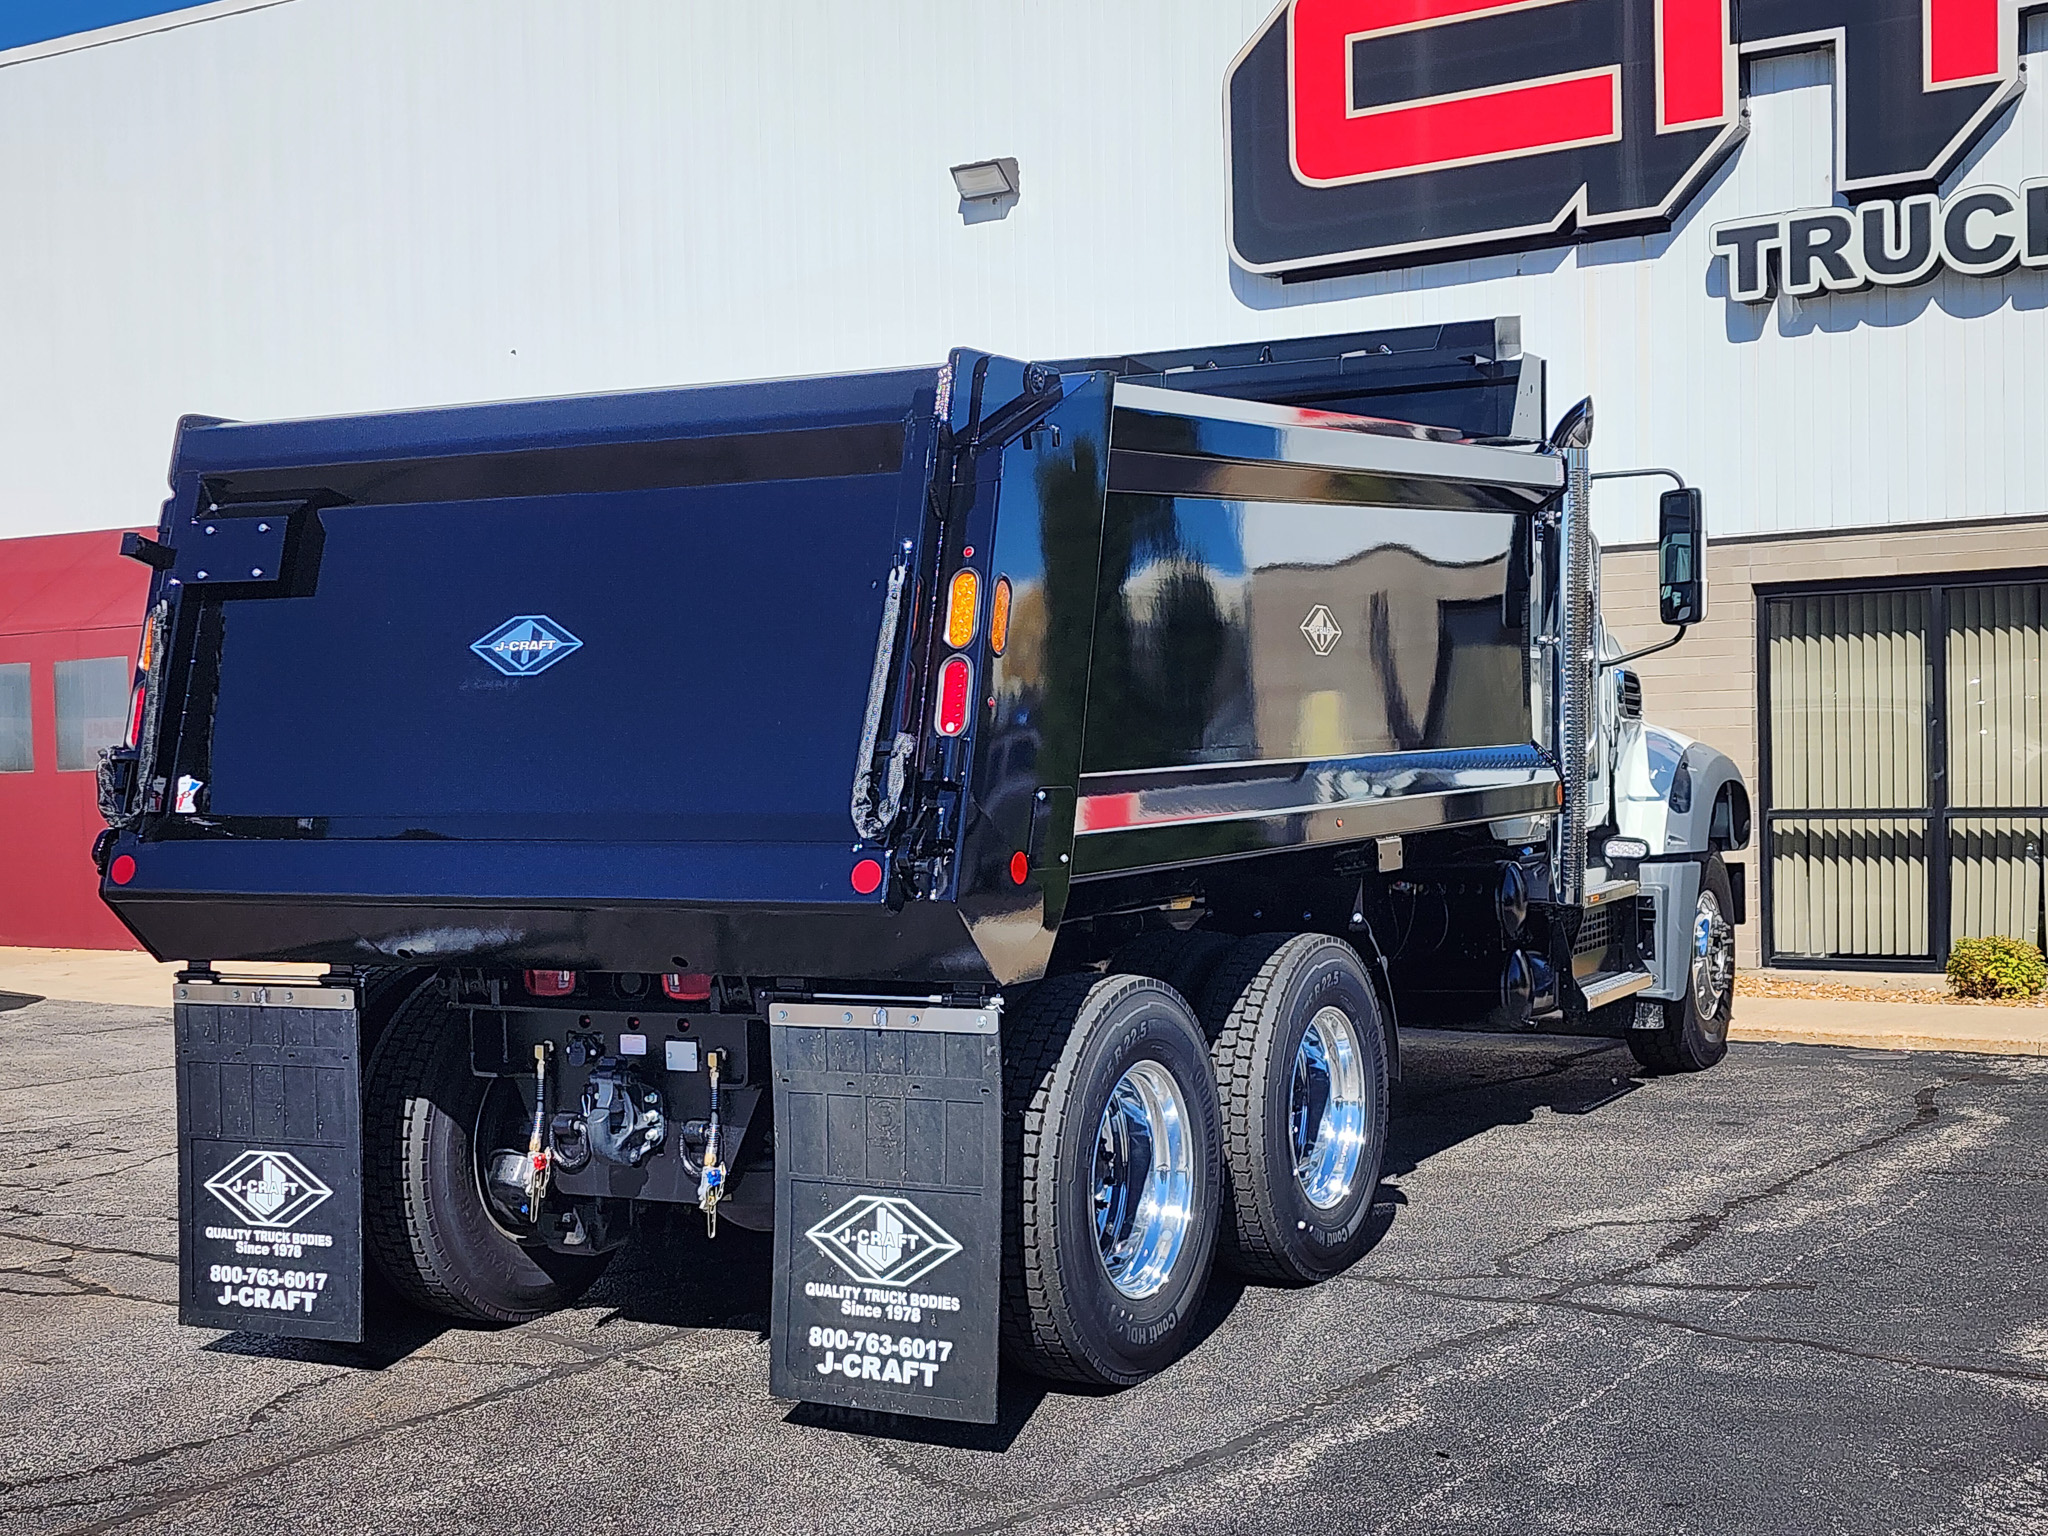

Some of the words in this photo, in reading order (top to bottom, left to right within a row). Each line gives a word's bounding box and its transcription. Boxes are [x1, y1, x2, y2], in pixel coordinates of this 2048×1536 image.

[495, 640, 556, 652] J-CRAFT
[1321, 970, 1340, 992] 22.5
[1123, 1020, 1148, 1052] 22.5
[232, 1179, 299, 1196] J-CRAFT
[205, 1226, 252, 1241] QUALITY
[253, 1230, 291, 1244] TRUCK
[292, 1233, 333, 1247] BODIES
[839, 1228, 920, 1250] J-CRAFT
[235, 1241, 270, 1256] Since
[272, 1244, 303, 1258] 1978
[210, 1265, 328, 1291] 800-763-6017
[217, 1285, 318, 1312] J-CRAFT
[805, 1282, 862, 1300] QUALITY
[863, 1287, 908, 1306] TRUCK
[910, 1292, 960, 1311] BODIES
[840, 1300, 882, 1318] Since
[884, 1306, 922, 1323] 1978
[1149, 1312, 1177, 1344] Conti
[808, 1326, 953, 1362] 800-763-6017
[815, 1351, 939, 1387] J-CRAFT
